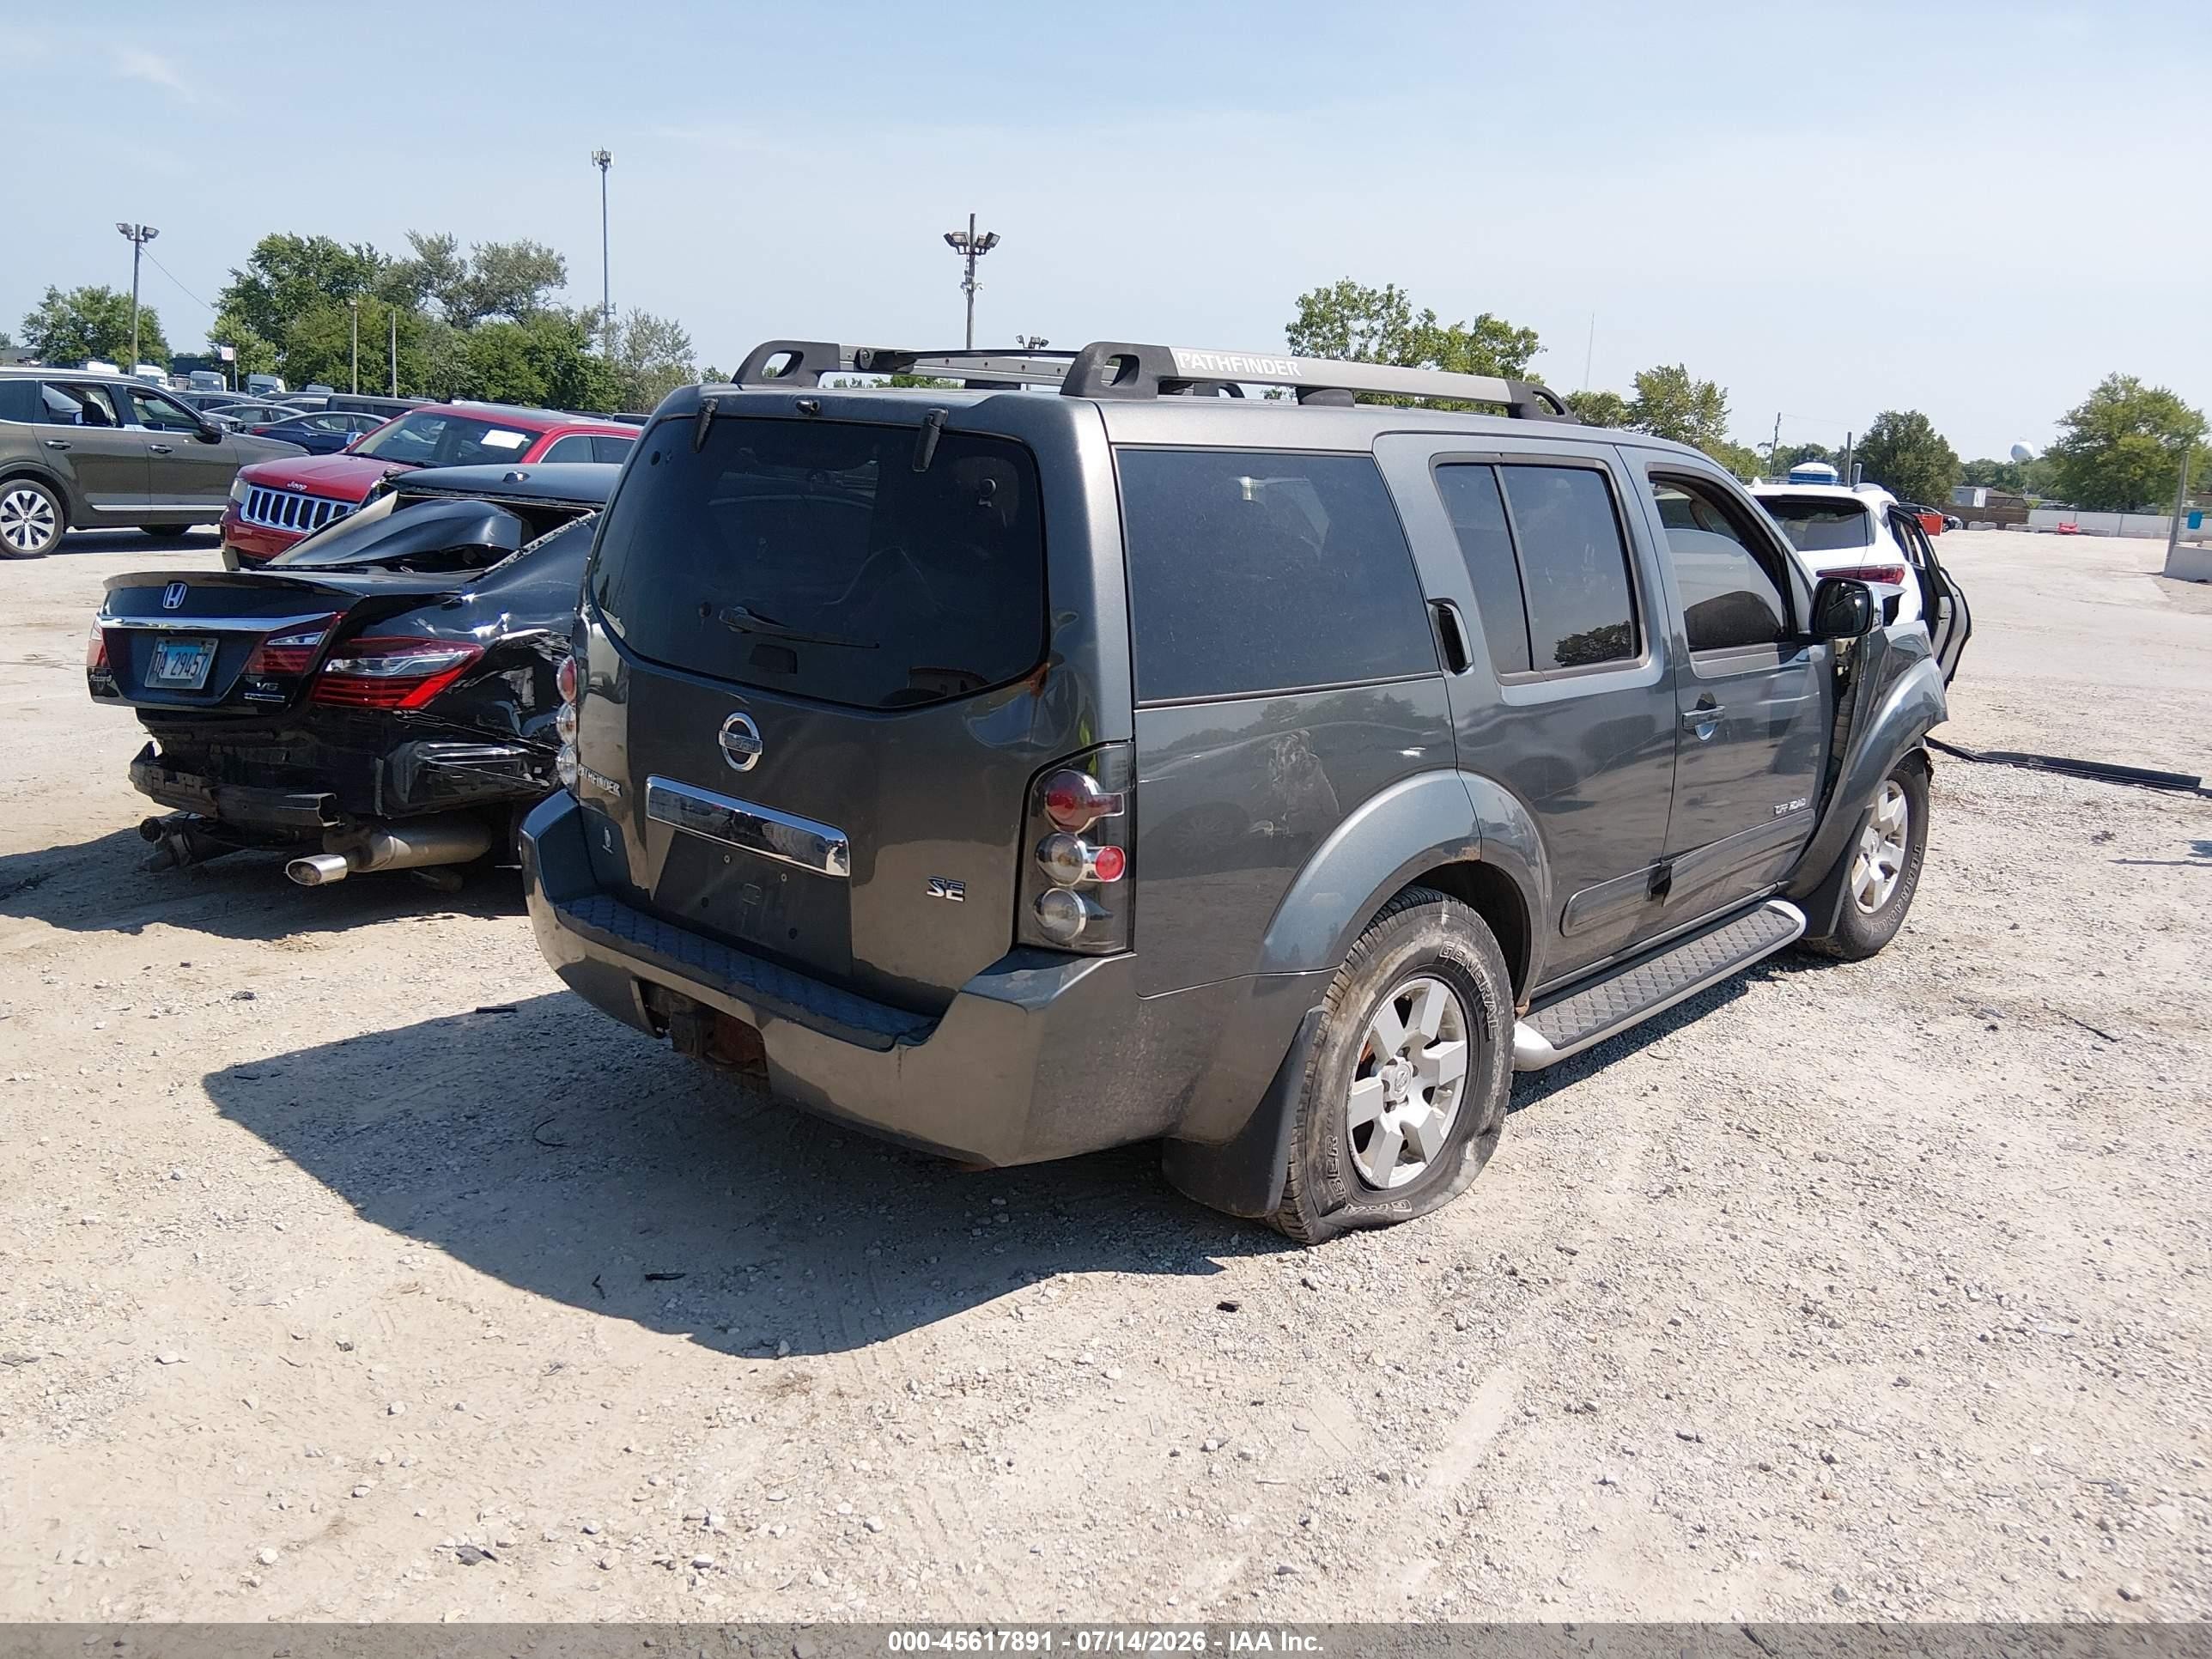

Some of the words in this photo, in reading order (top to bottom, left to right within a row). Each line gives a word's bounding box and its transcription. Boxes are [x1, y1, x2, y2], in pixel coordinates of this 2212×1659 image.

[1176, 351, 1303, 377] PATHFINDER
[286, 481, 308, 491] Jeep
[256, 682, 279, 691] V6
[927, 876, 965, 902] SE
[1438, 940, 1499, 1040] GENERAL
